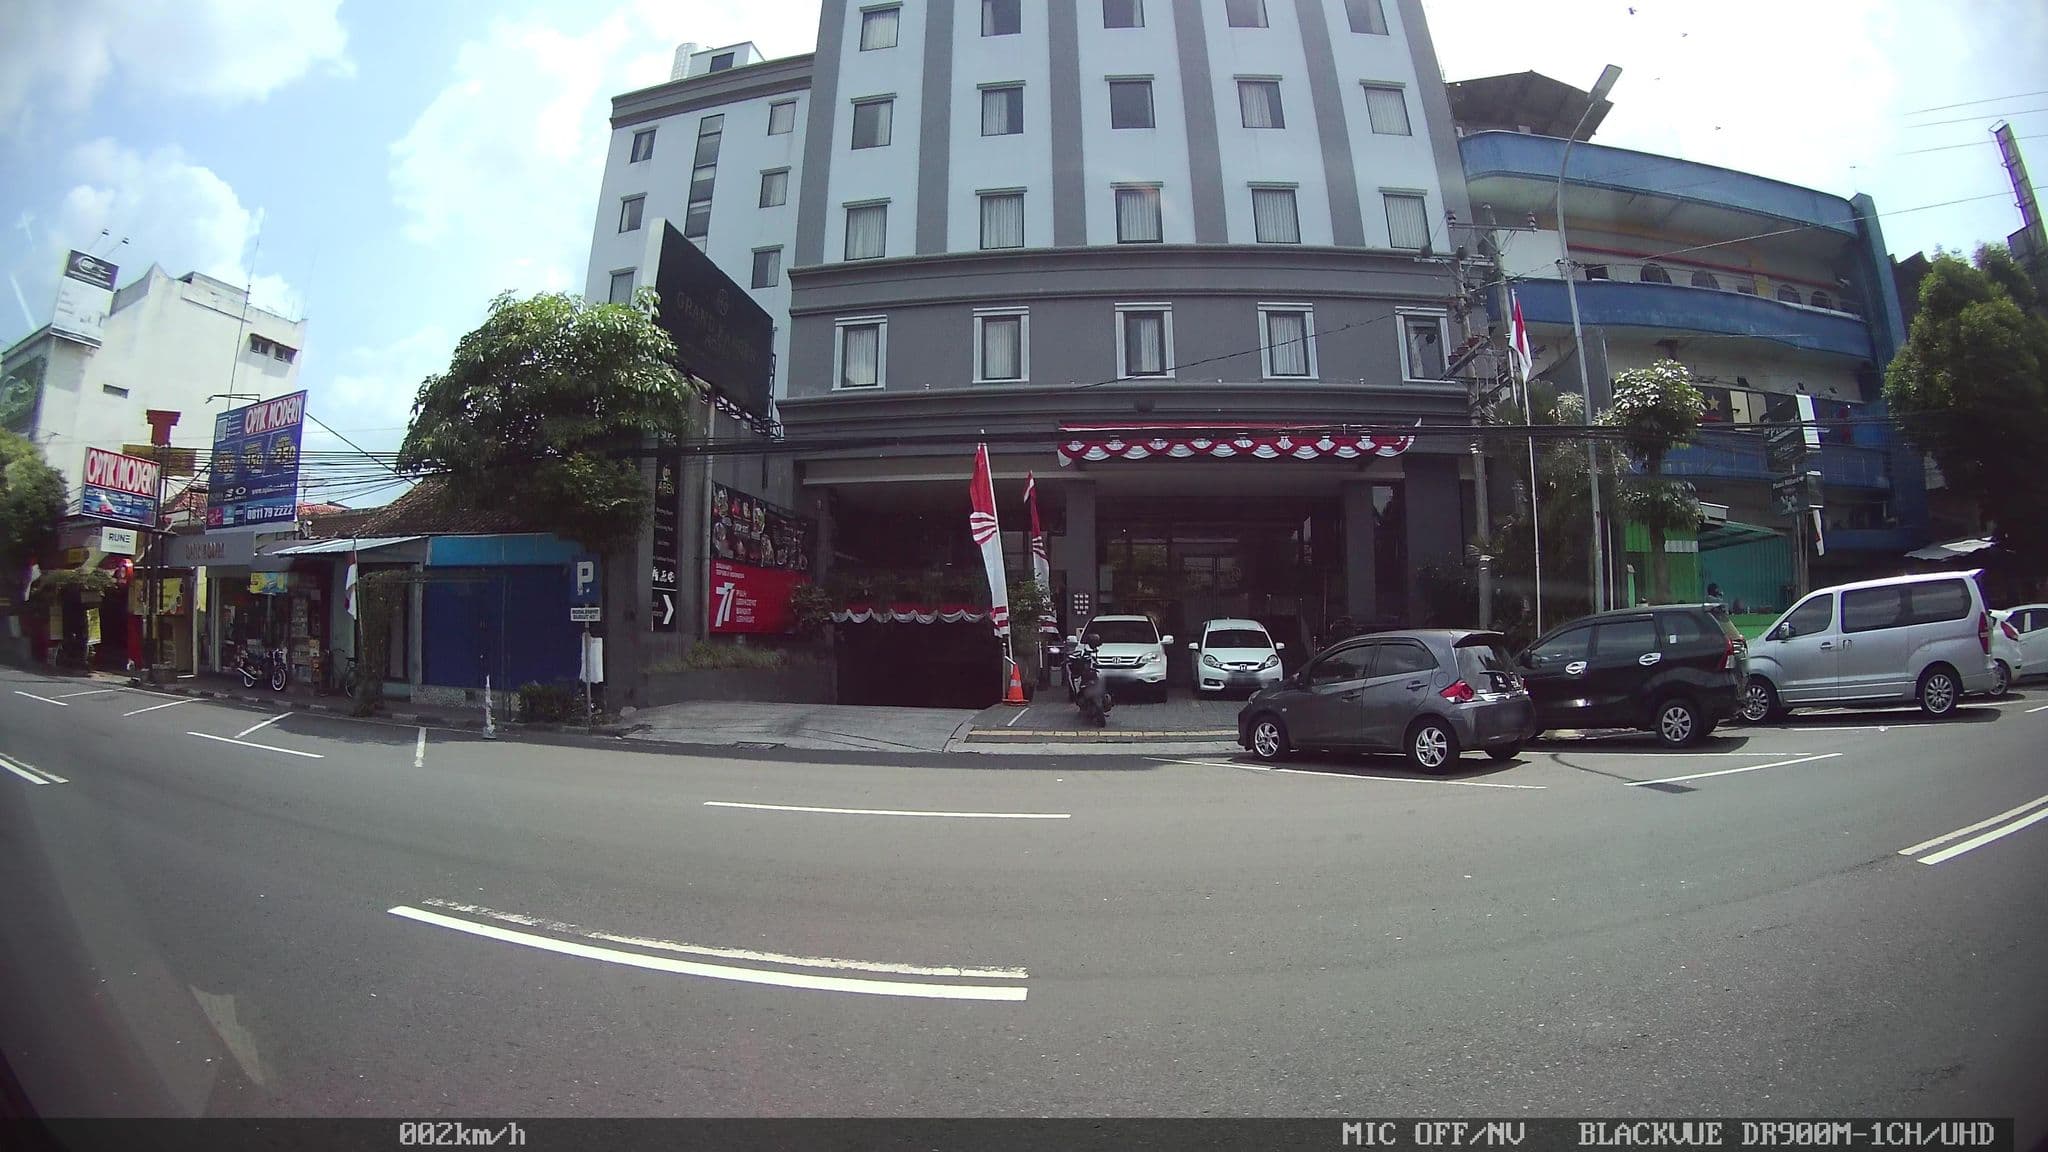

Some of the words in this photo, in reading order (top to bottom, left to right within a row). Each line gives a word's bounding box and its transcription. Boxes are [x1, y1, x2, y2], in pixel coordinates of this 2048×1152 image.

[246, 406, 268, 434] OPTIK
[268, 396, 304, 426] MODERN
[88, 450, 114, 486] OPTIK
[116, 456, 159, 496] MODERN
[274, 504, 293, 516] 2222
[108, 533, 131, 543] RUNE
[576, 561, 594, 596] P
